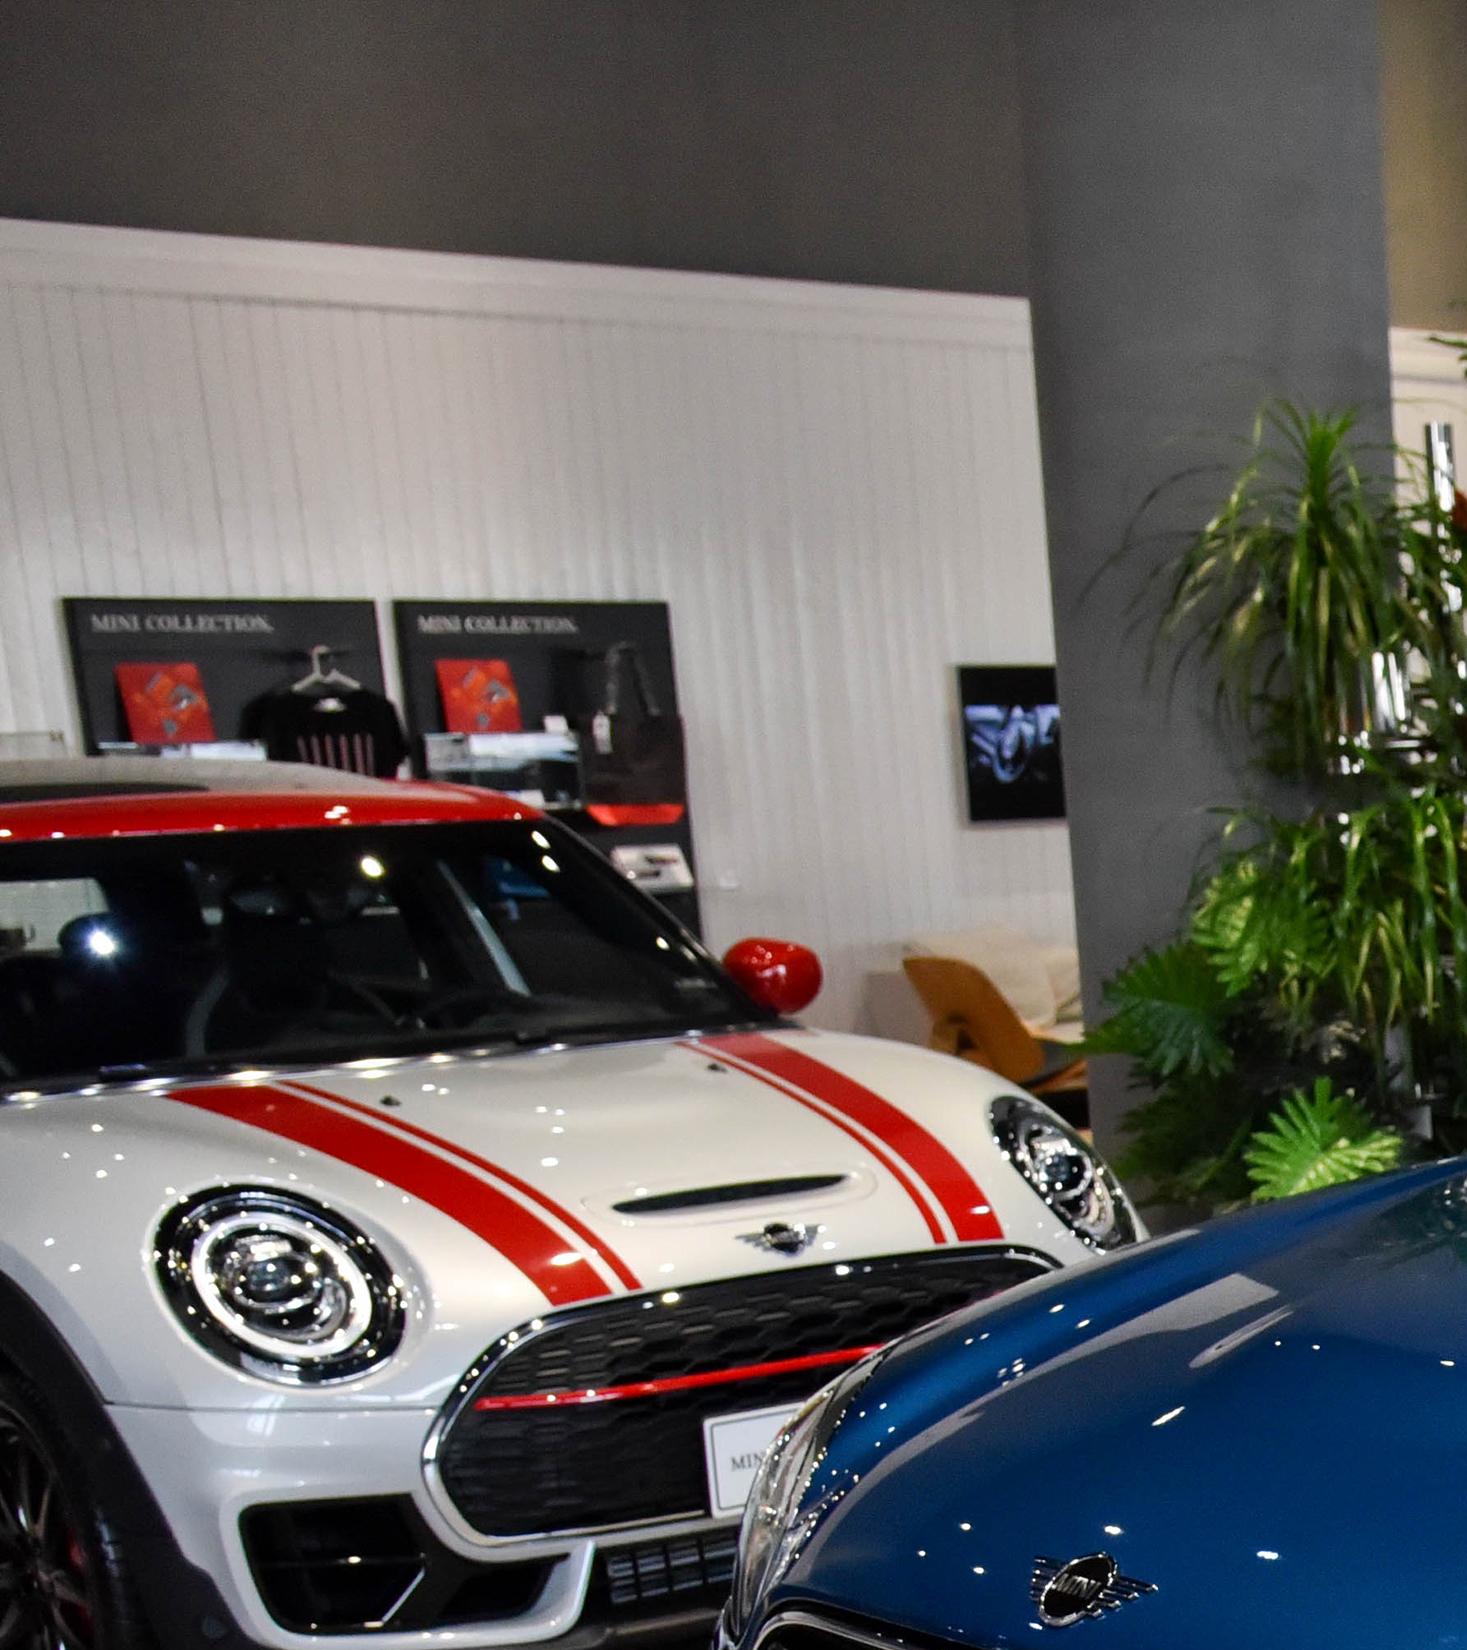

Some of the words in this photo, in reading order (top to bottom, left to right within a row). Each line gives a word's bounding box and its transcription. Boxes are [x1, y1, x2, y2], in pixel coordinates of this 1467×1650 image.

[90, 613, 140, 633] MINI
[417, 614, 461, 634] MINI
[731, 1451, 766, 1471] MIN
